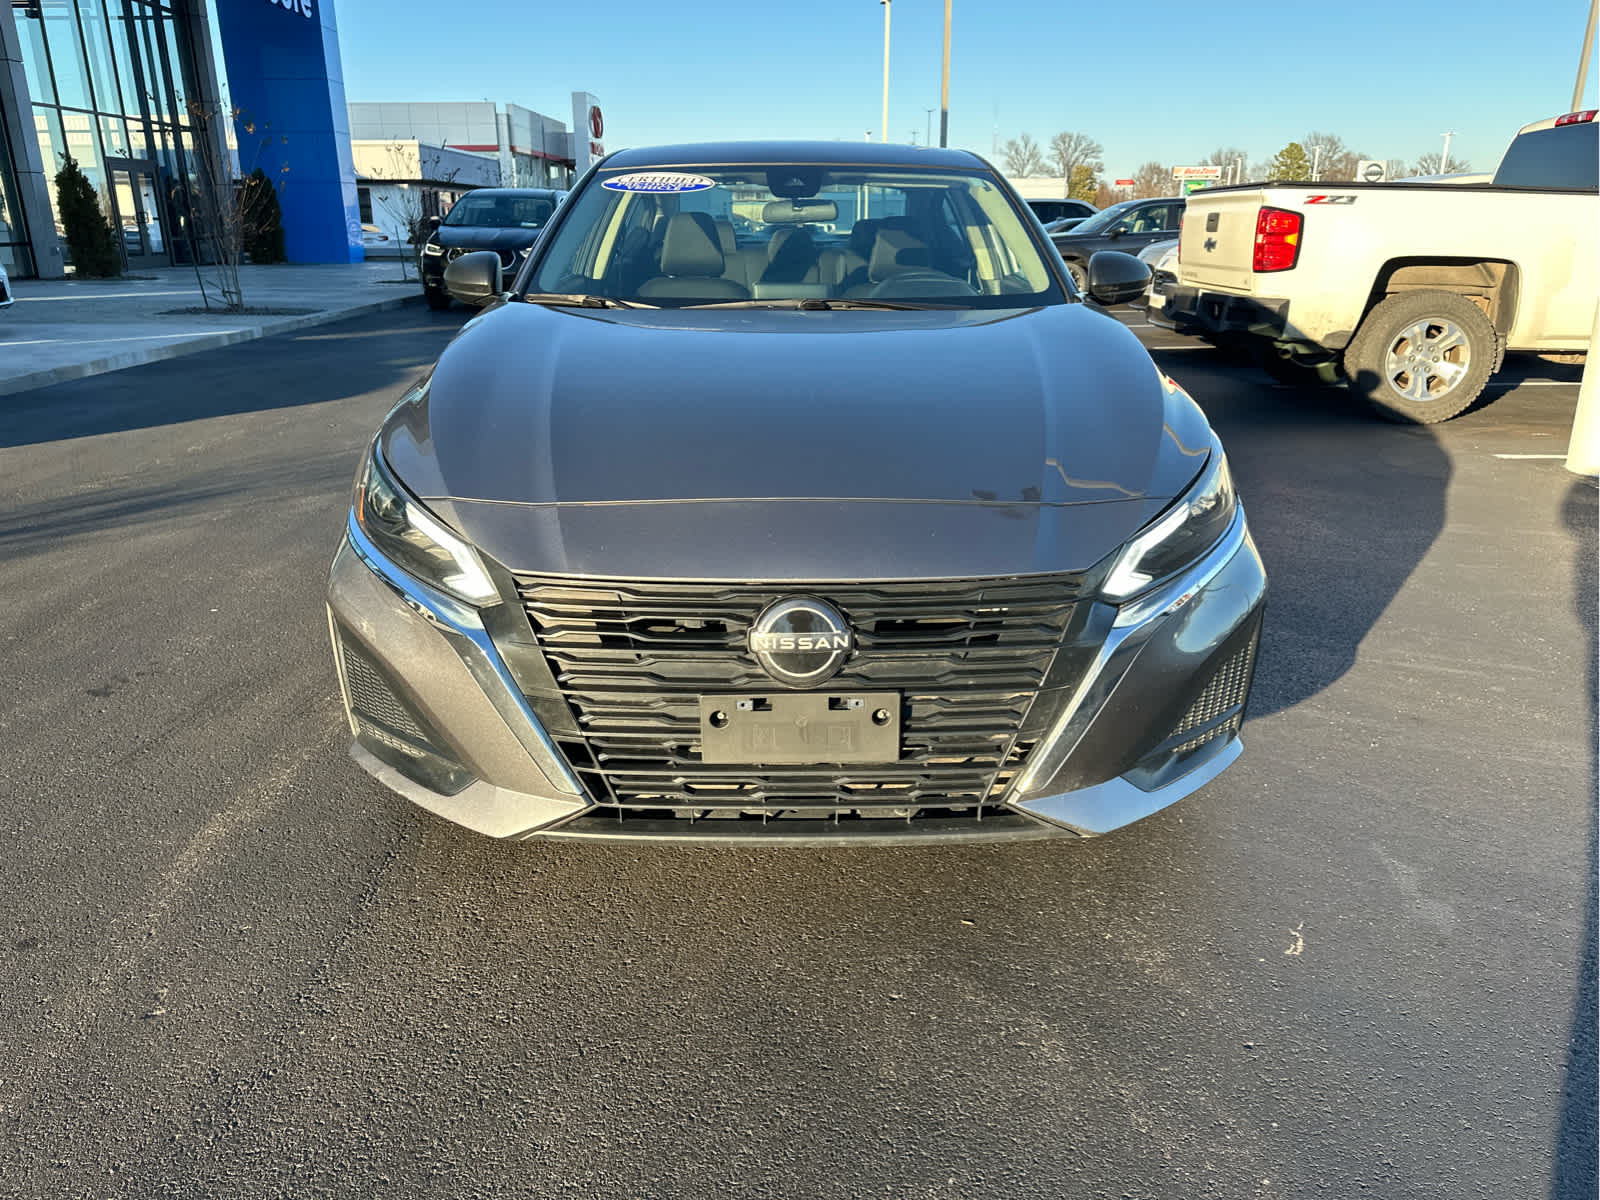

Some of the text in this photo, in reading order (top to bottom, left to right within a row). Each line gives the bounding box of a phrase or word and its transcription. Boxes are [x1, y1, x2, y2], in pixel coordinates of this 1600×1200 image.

[617, 175, 704, 184] CERTIFIED
[1304, 195, 1358, 205] Z71
[753, 635, 849, 650] NISSAN
